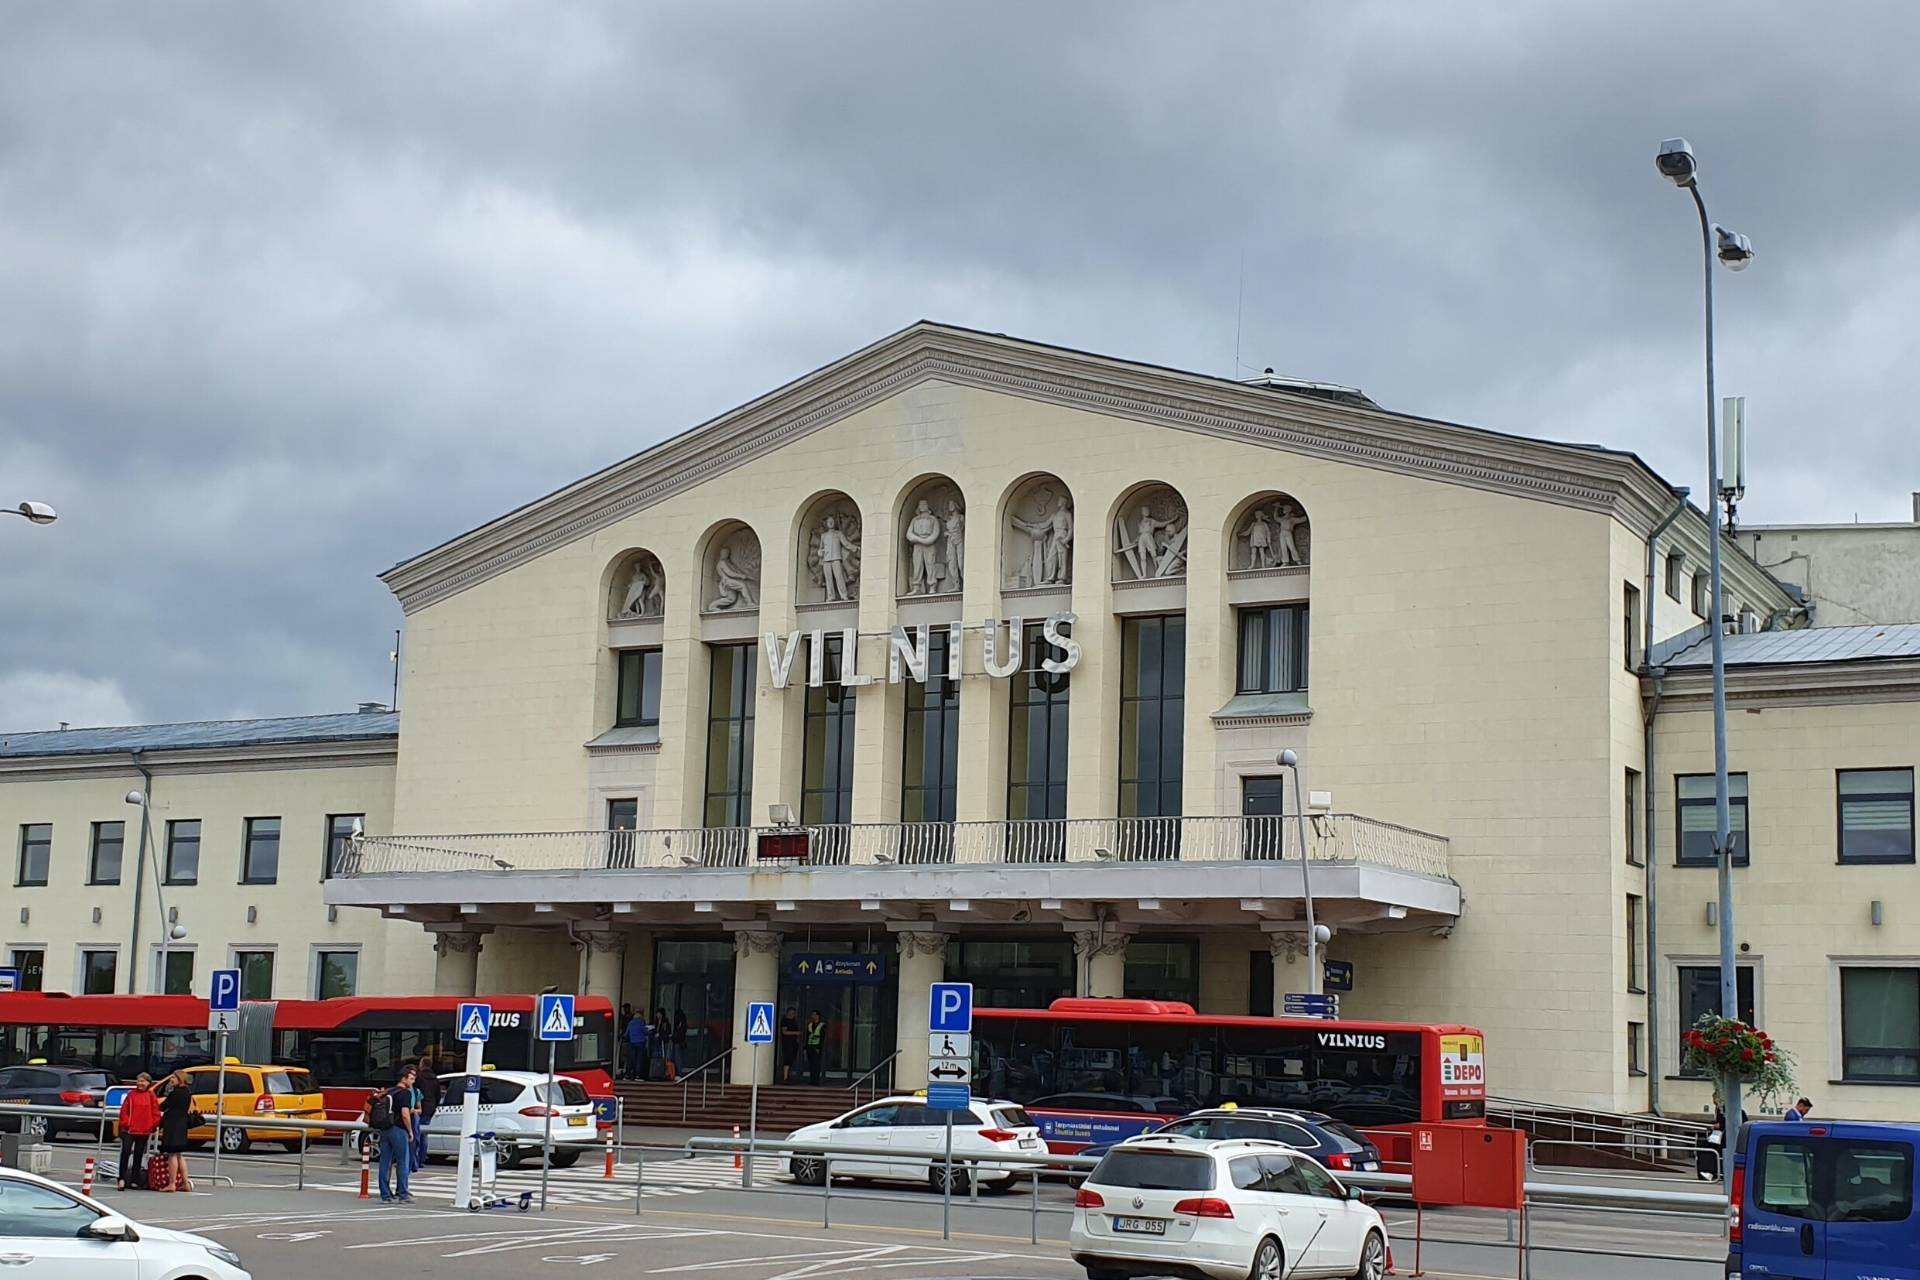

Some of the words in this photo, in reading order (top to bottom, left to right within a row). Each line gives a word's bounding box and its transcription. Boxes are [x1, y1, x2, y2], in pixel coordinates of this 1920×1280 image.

[765, 611, 1082, 689] VILNIUS
[815, 960, 823, 974] A
[217, 974, 234, 1005] P
[940, 990, 962, 1025] P
[1317, 1033, 1386, 1049] VILNIUS
[1454, 1064, 1482, 1080] DEPO
[1119, 1219, 1139, 1230] JRG
[1145, 1220, 1163, 1232] 055
